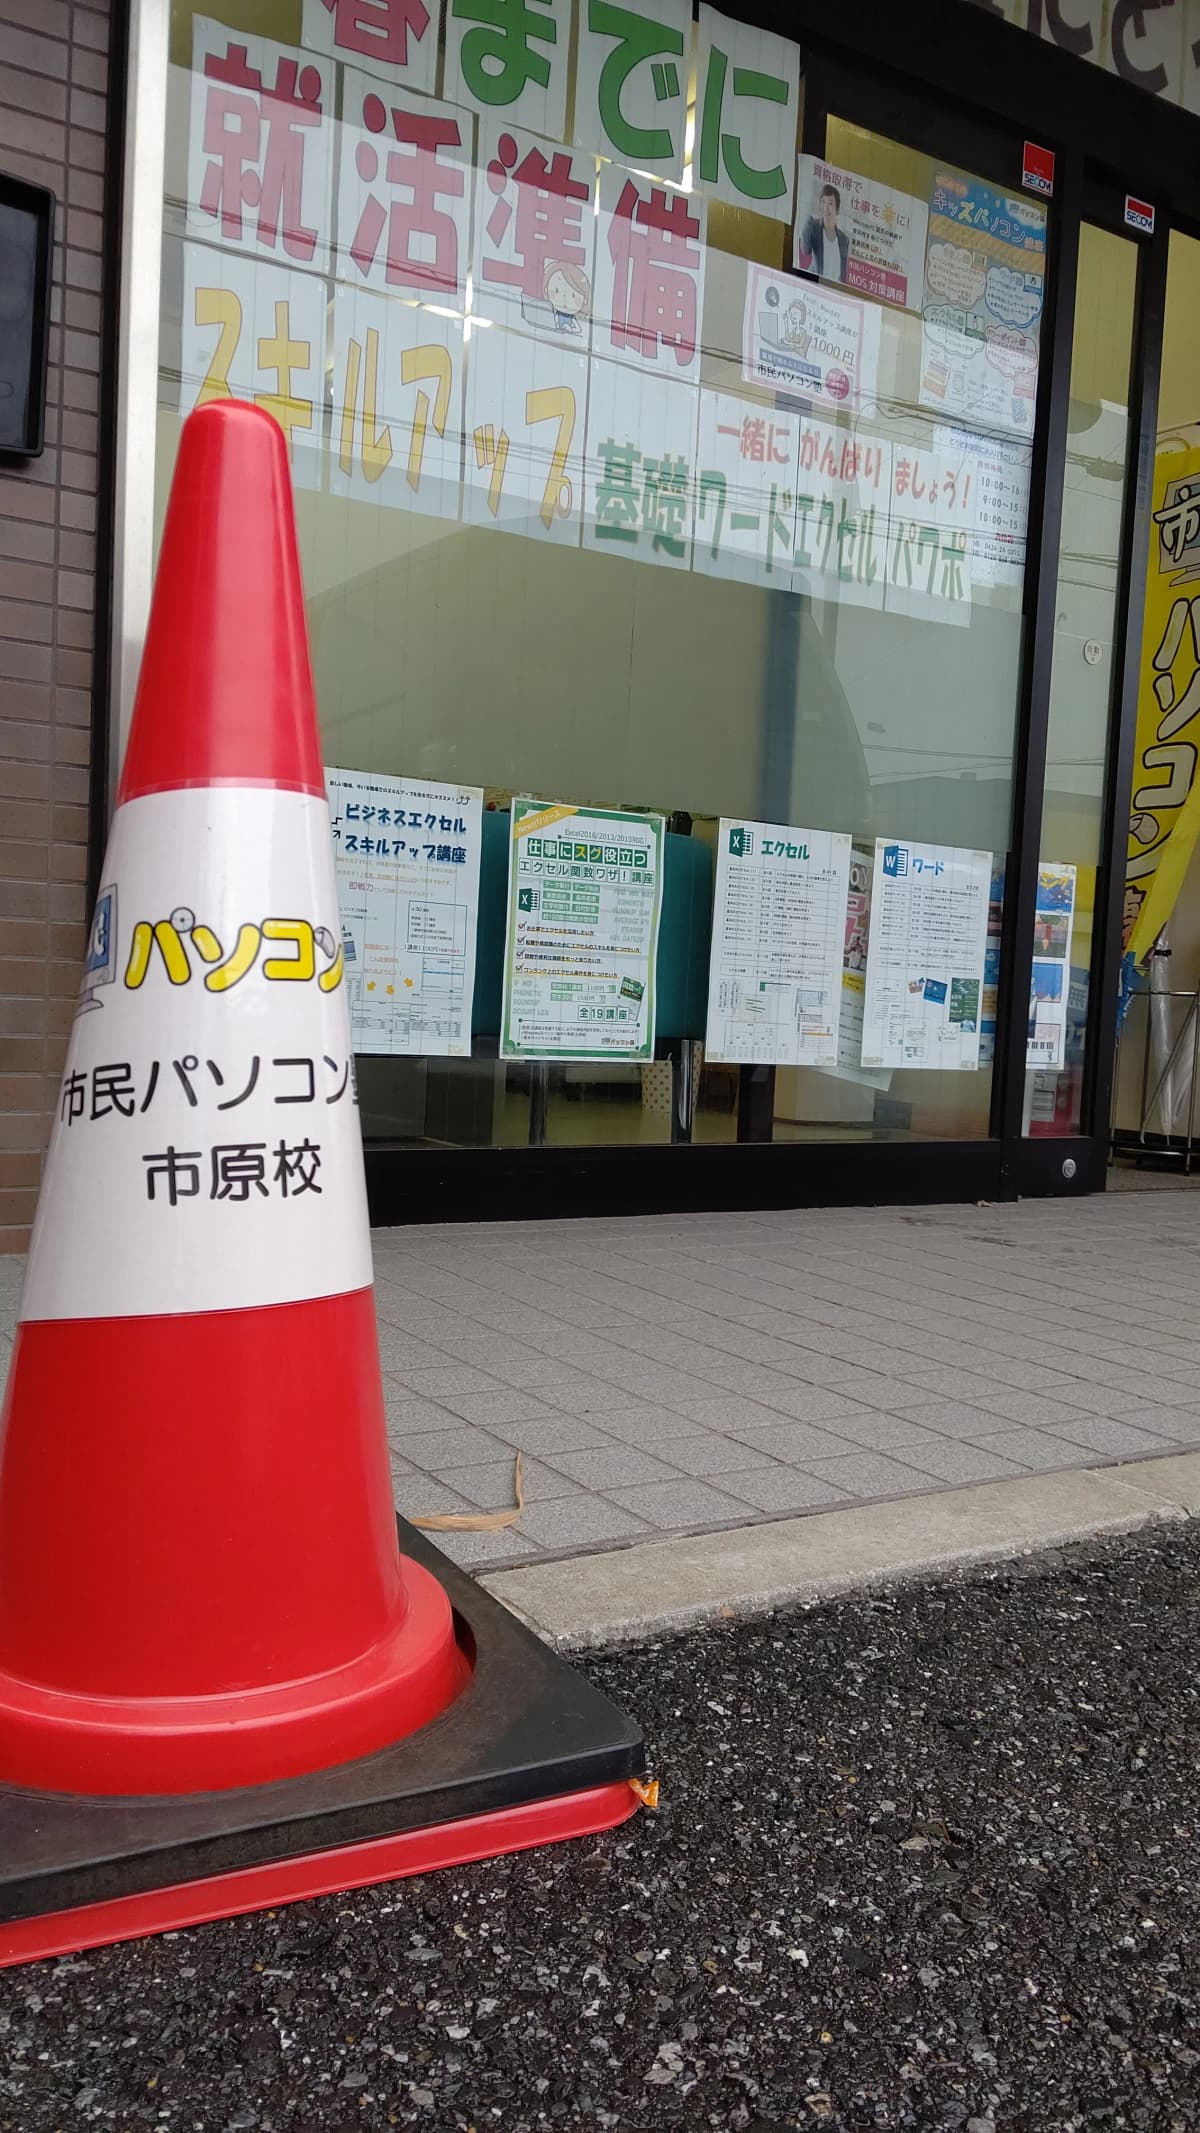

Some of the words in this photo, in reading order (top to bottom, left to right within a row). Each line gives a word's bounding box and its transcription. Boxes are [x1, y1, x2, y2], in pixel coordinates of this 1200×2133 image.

[1024, 173, 1051, 192] SECOM
[200, 42, 700, 367] 就活準備
[1126, 210, 1152, 230] SECOM
[848, 272, 868, 289] MOS
[757, 364, 822, 393] 市民パソコン塾
[193, 286, 576, 530] スキルアップ
[717, 414, 791, 464] 一緒に
[800, 427, 882, 488] がんばり
[345, 803, 467, 834] ビジネスエクセル
[344, 834, 468, 865] スキルアップ講座
[528, 838, 648, 868] 仕事にスグ役立つ
[761, 840, 811, 861] エクセル
[519, 859, 655, 886] エクセル関数ワザ!講座
[912, 858, 945, 877] ワード
[125, 906, 344, 993] パソコン
[578, 1006, 629, 1021] 全19講座
[61, 1054, 359, 1127] 市民パソコン
[142, 1138, 323, 1206] 市原校
